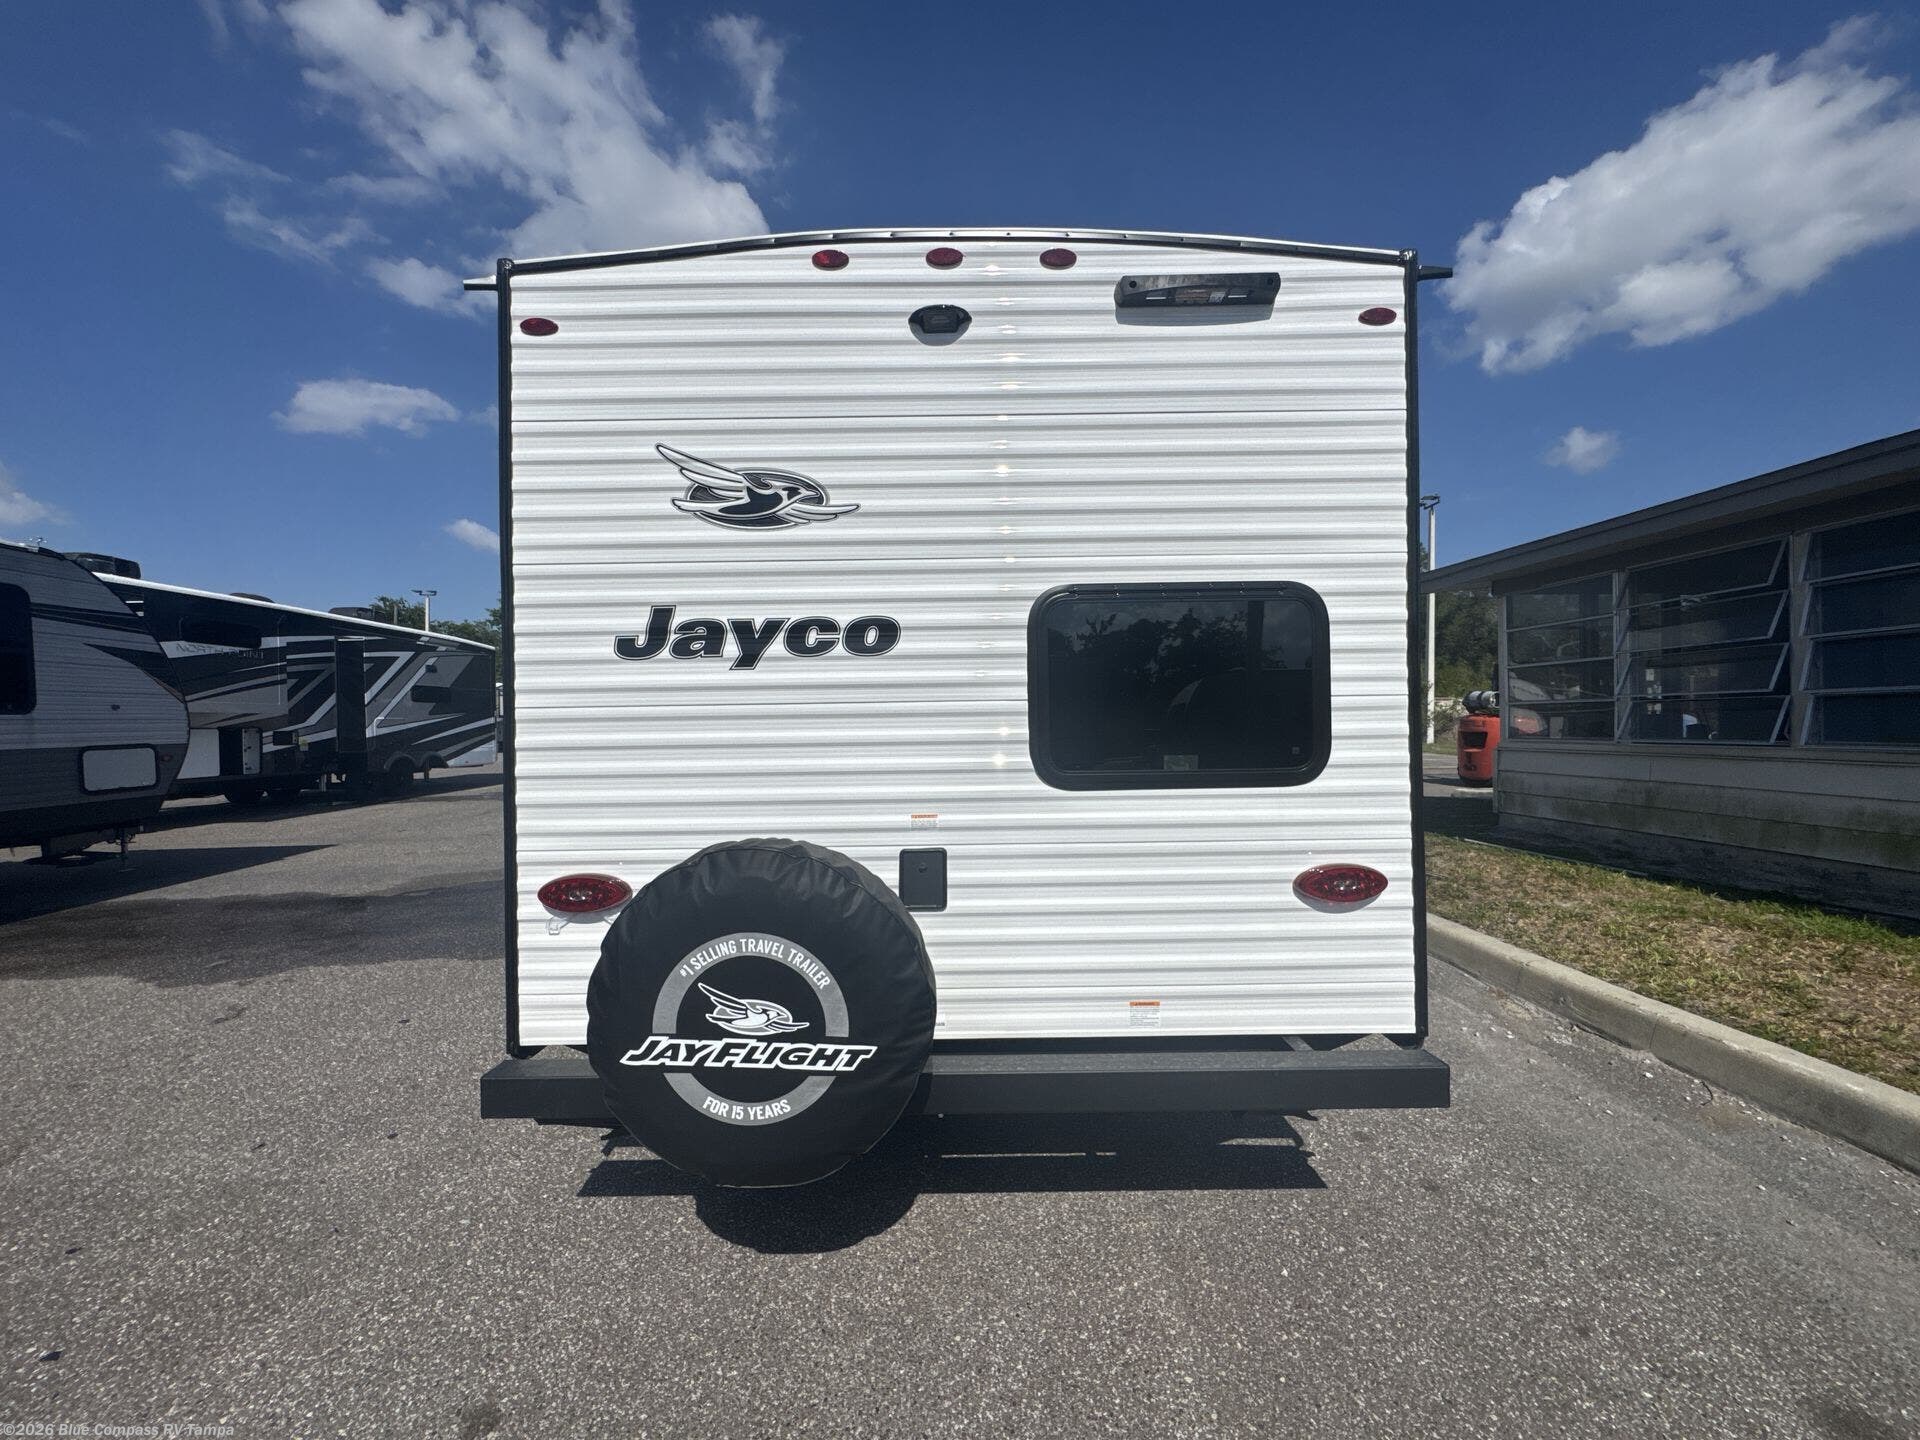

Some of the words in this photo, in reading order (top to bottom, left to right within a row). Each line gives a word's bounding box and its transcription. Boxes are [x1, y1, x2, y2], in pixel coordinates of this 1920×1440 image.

[614, 605, 901, 670] Jayco
[679, 964, 695, 977] #1
[690, 940, 737, 970] SELLING
[740, 938, 785, 959] TRAVEL
[787, 948, 831, 990] TRAILER
[703, 1096, 727, 1118] FOR
[732, 1105, 744, 1120] 15
[749, 1099, 791, 1120] YEARS
